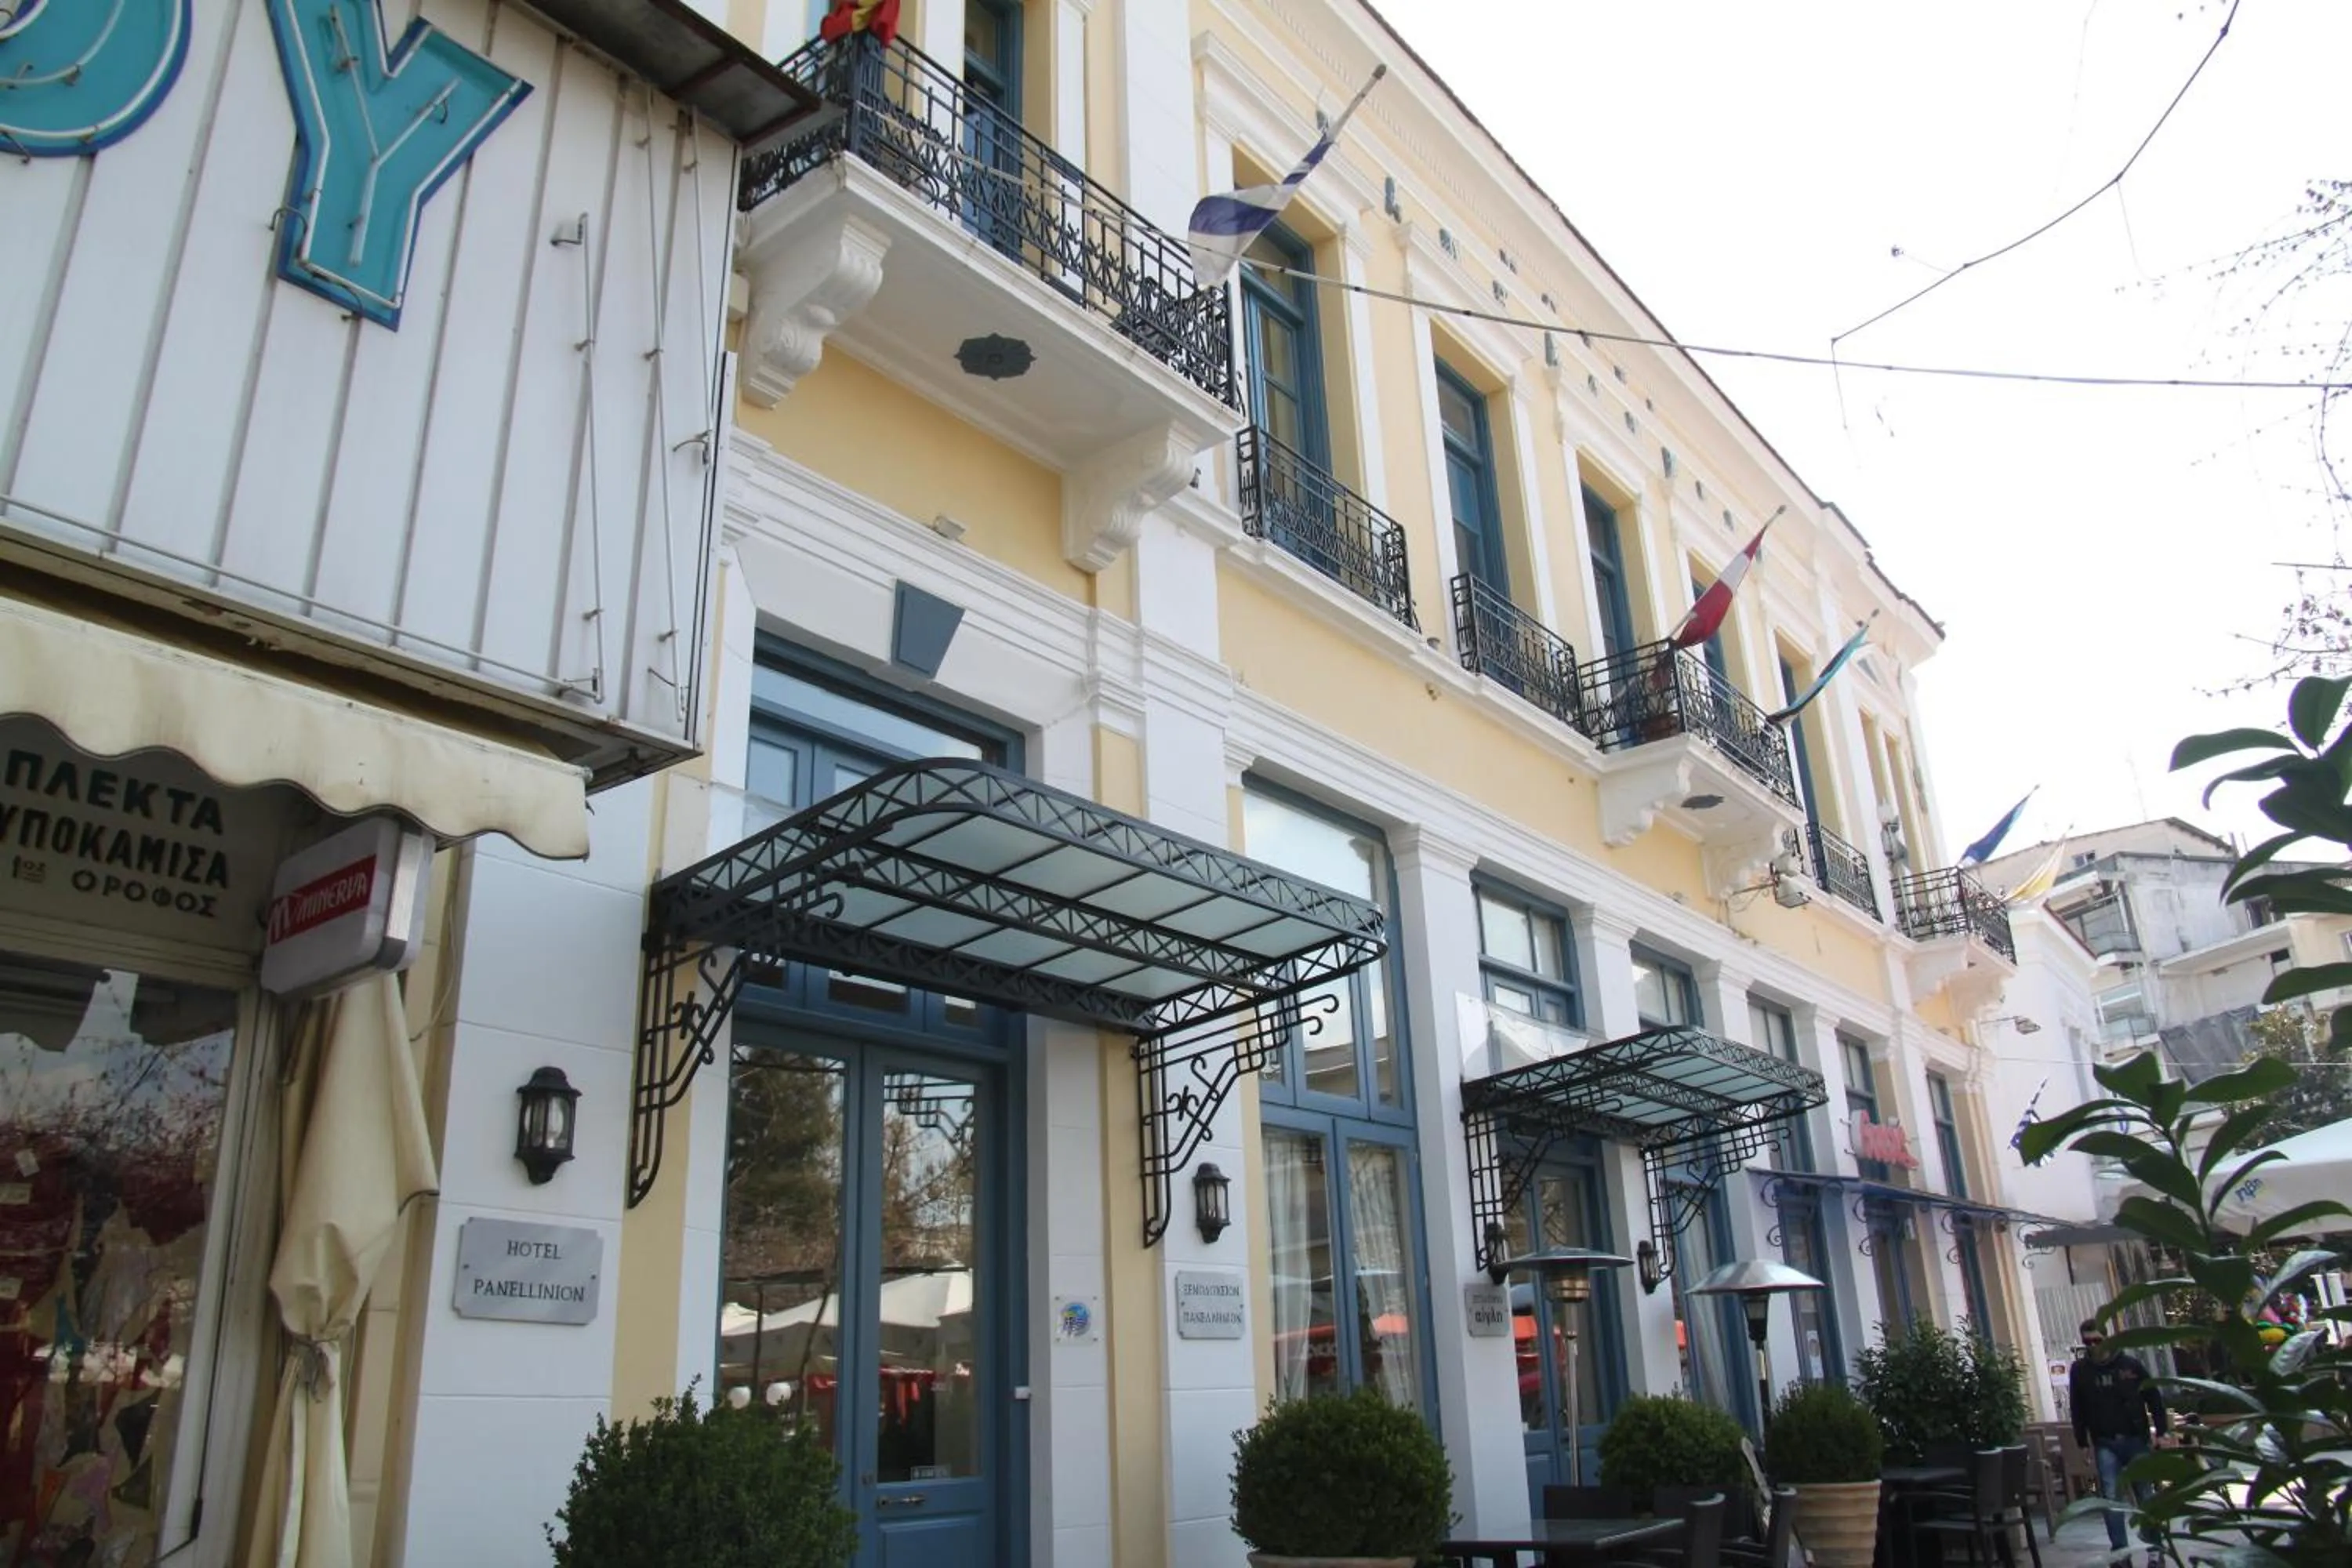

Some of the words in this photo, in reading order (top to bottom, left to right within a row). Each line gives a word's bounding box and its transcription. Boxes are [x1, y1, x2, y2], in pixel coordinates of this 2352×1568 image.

[5, 749, 223, 835] ΠΛΕΚΤΑ
[0, 802, 230, 890] ΥΠΟΚΑΜΙΣΑ
[71, 868, 218, 918] ΟΡΟΦΟΣ
[506, 1240, 562, 1260] HOTEL
[474, 1279, 586, 1302] PANELLINION
